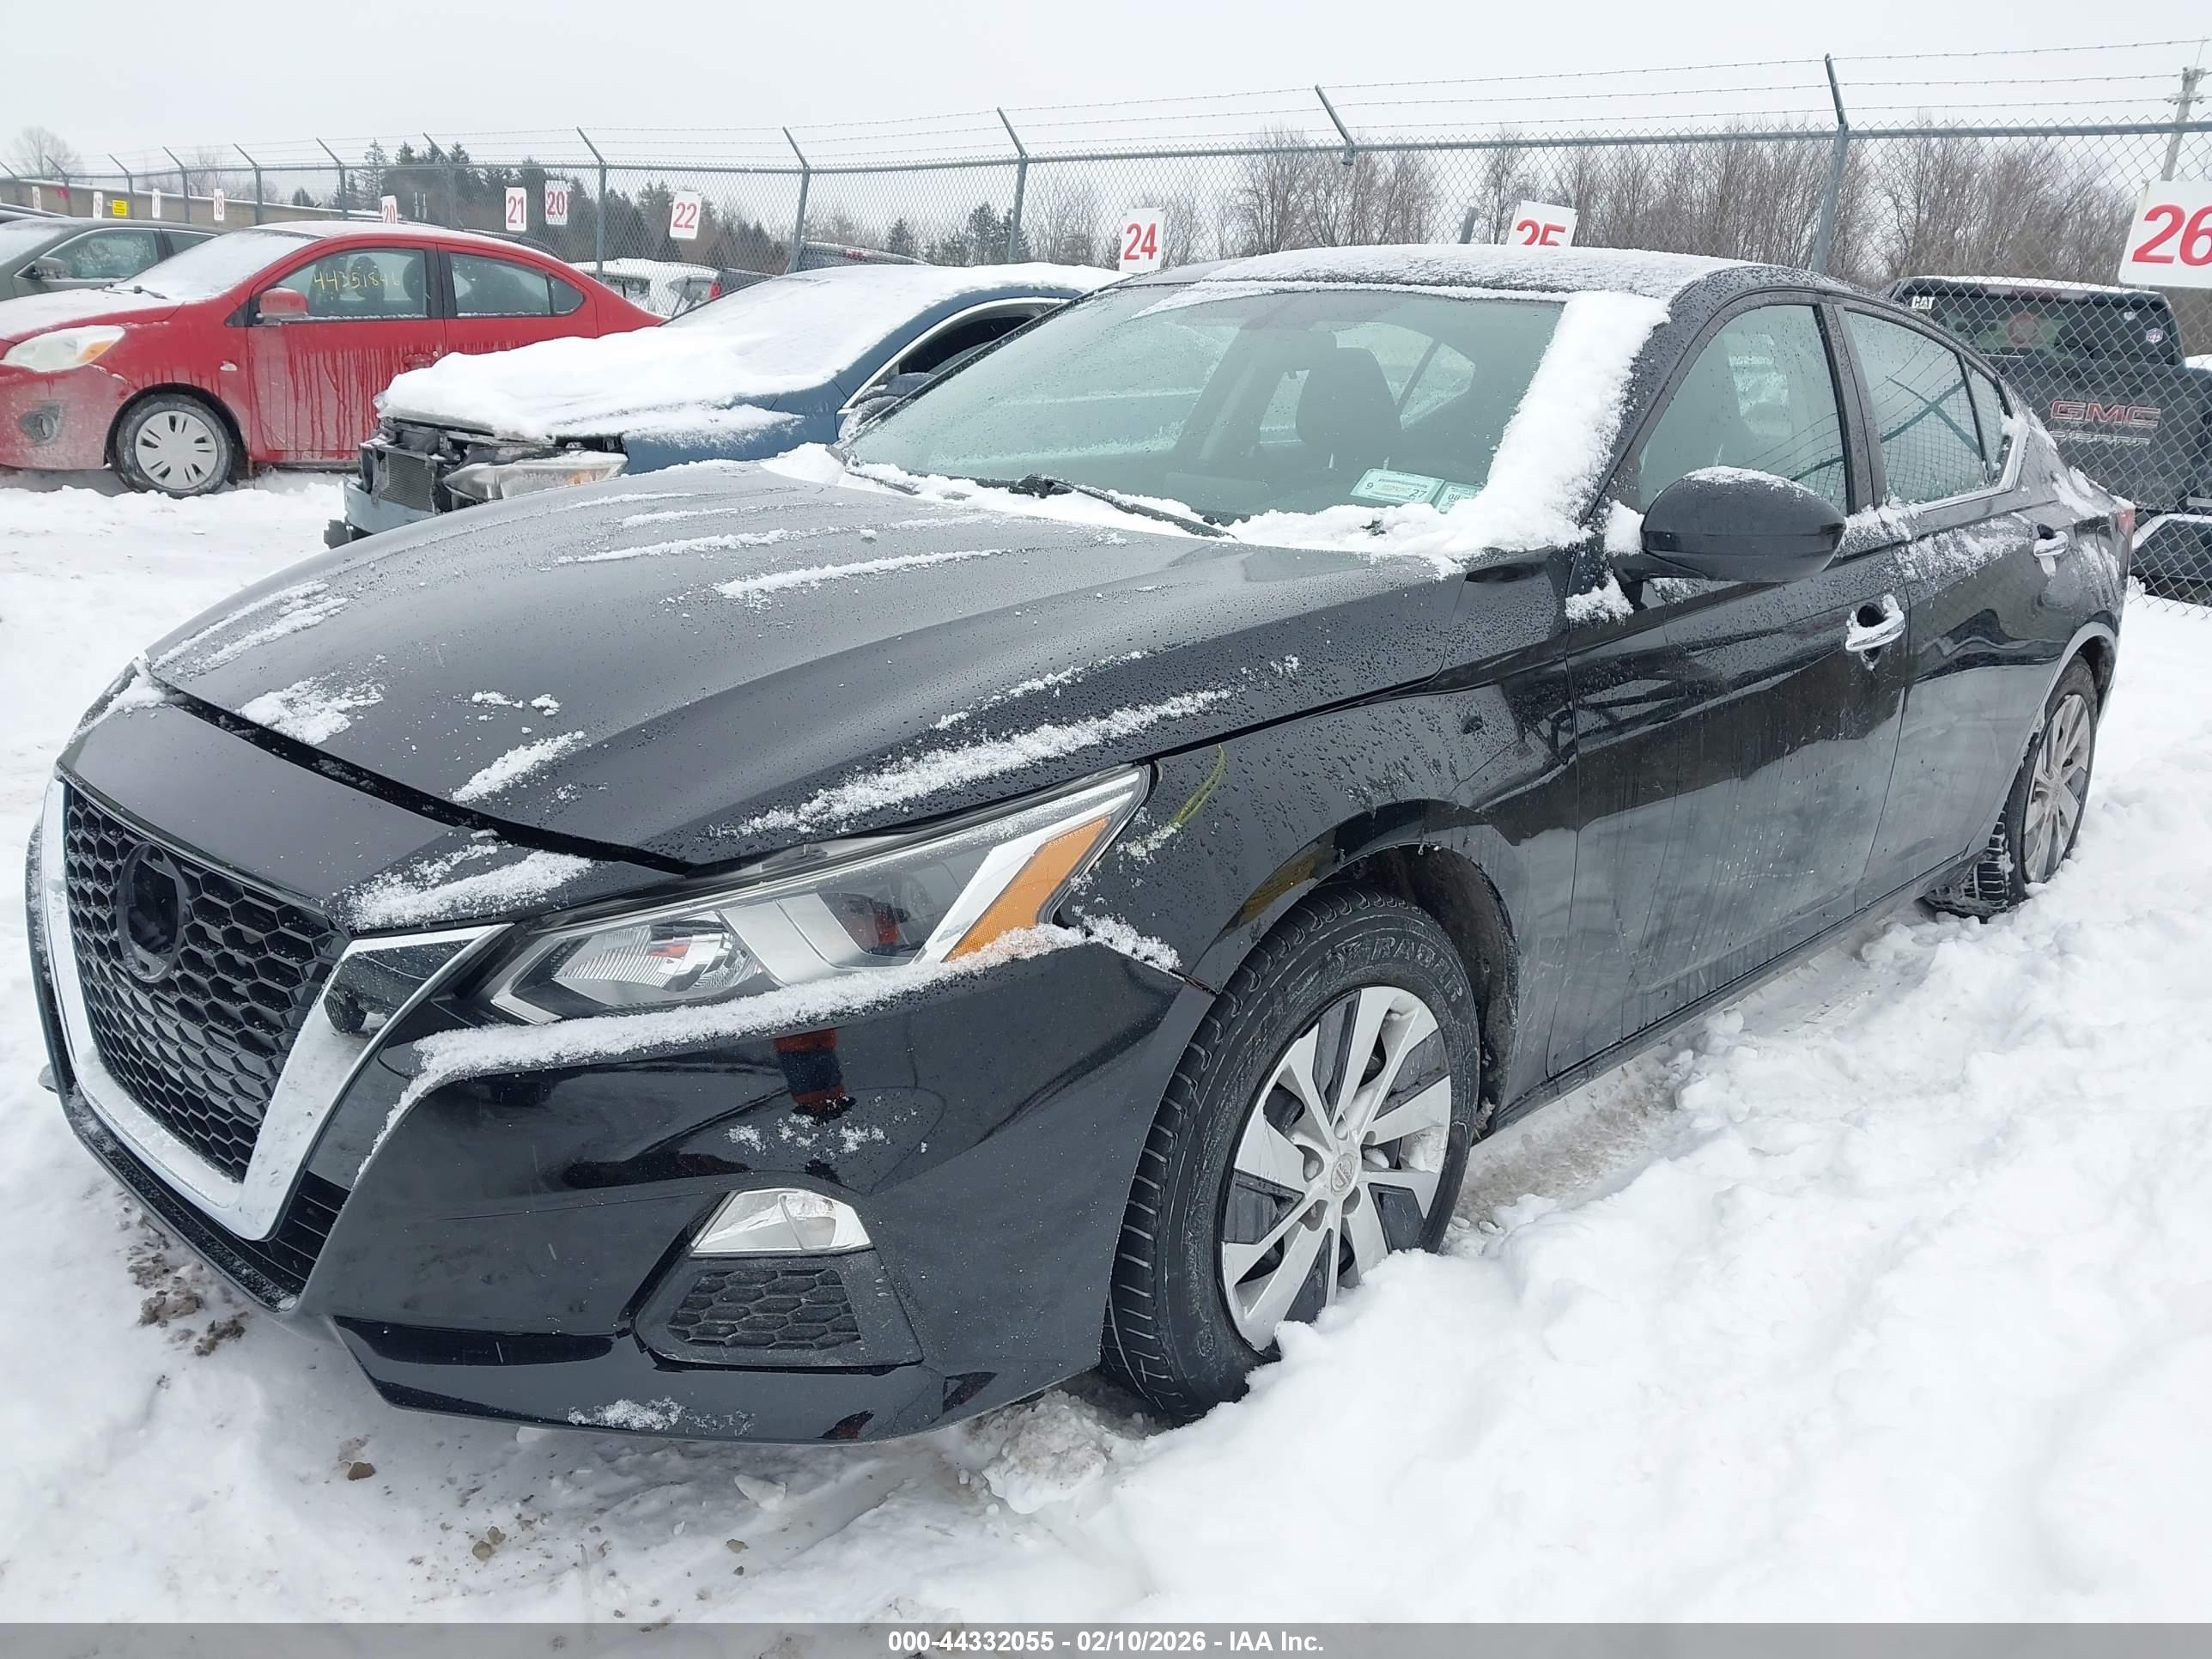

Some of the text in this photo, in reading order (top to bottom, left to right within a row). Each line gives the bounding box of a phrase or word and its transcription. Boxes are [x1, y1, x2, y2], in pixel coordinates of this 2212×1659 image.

[215, 195, 223, 215] 18
[507, 196, 525, 224] 21
[546, 191, 565, 216] 20
[672, 202, 698, 229] 22
[1123, 222, 1158, 260] 24
[1516, 218, 1567, 246] 25
[2131, 204, 2212, 266] 26
[1911, 295, 1936, 309] CAT
[2050, 399, 2161, 428] GMC
[1408, 489, 1428, 500] 27
